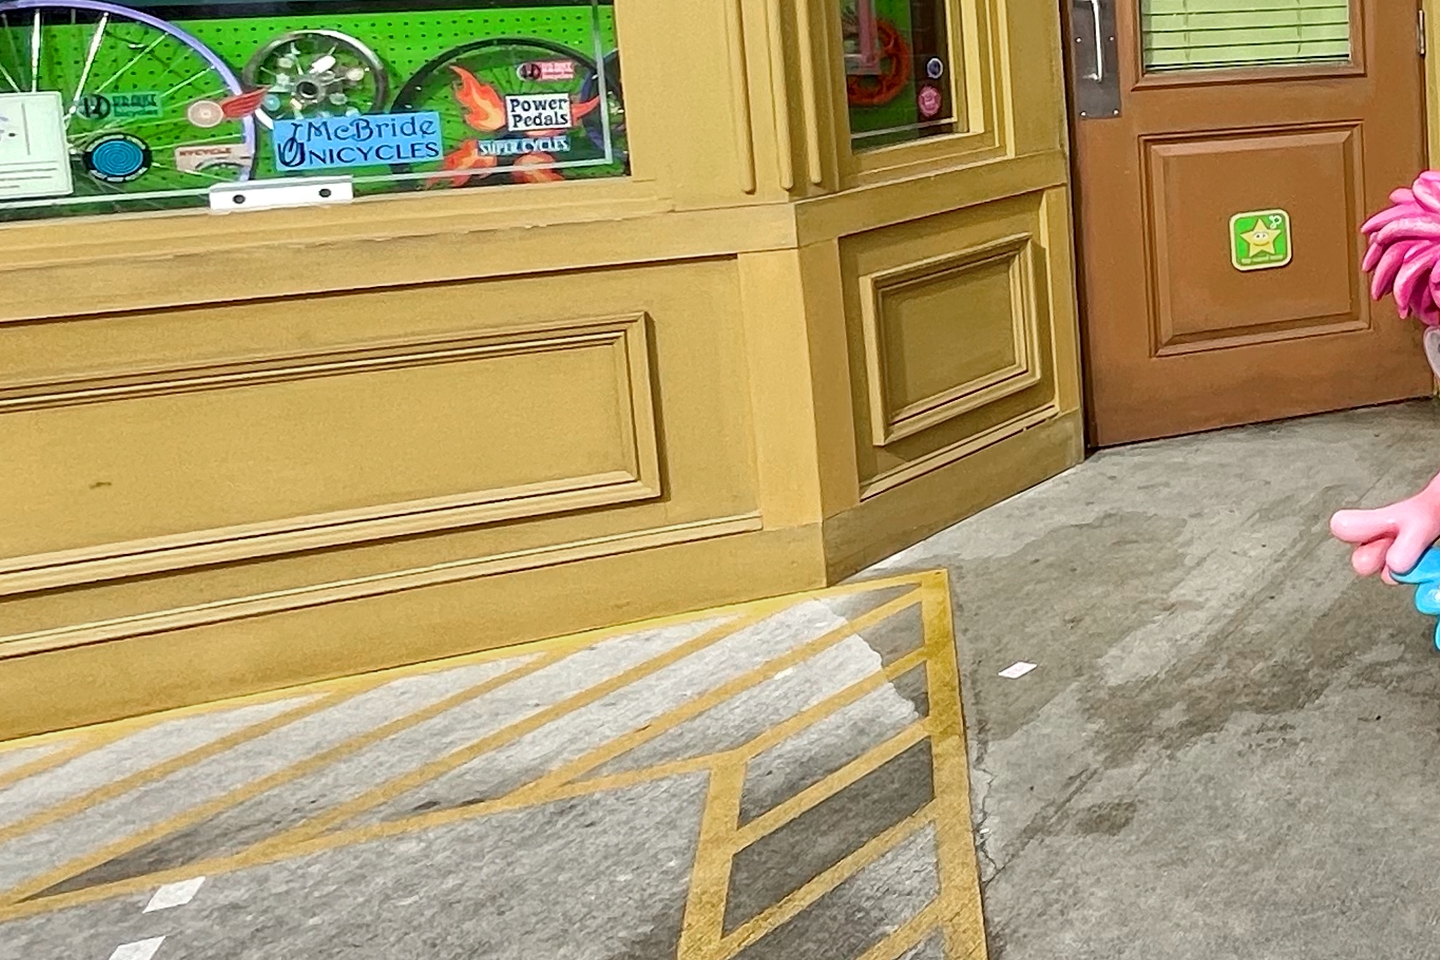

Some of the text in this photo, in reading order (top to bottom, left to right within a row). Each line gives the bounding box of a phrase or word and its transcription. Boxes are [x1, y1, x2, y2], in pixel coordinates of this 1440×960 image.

[510, 98, 568, 113] Power
[306, 116, 436, 141] McBride
[512, 112, 569, 128] Pedals
[277, 139, 440, 168] UNICYCLES
[479, 138, 569, 155] SUPER CYCLES
